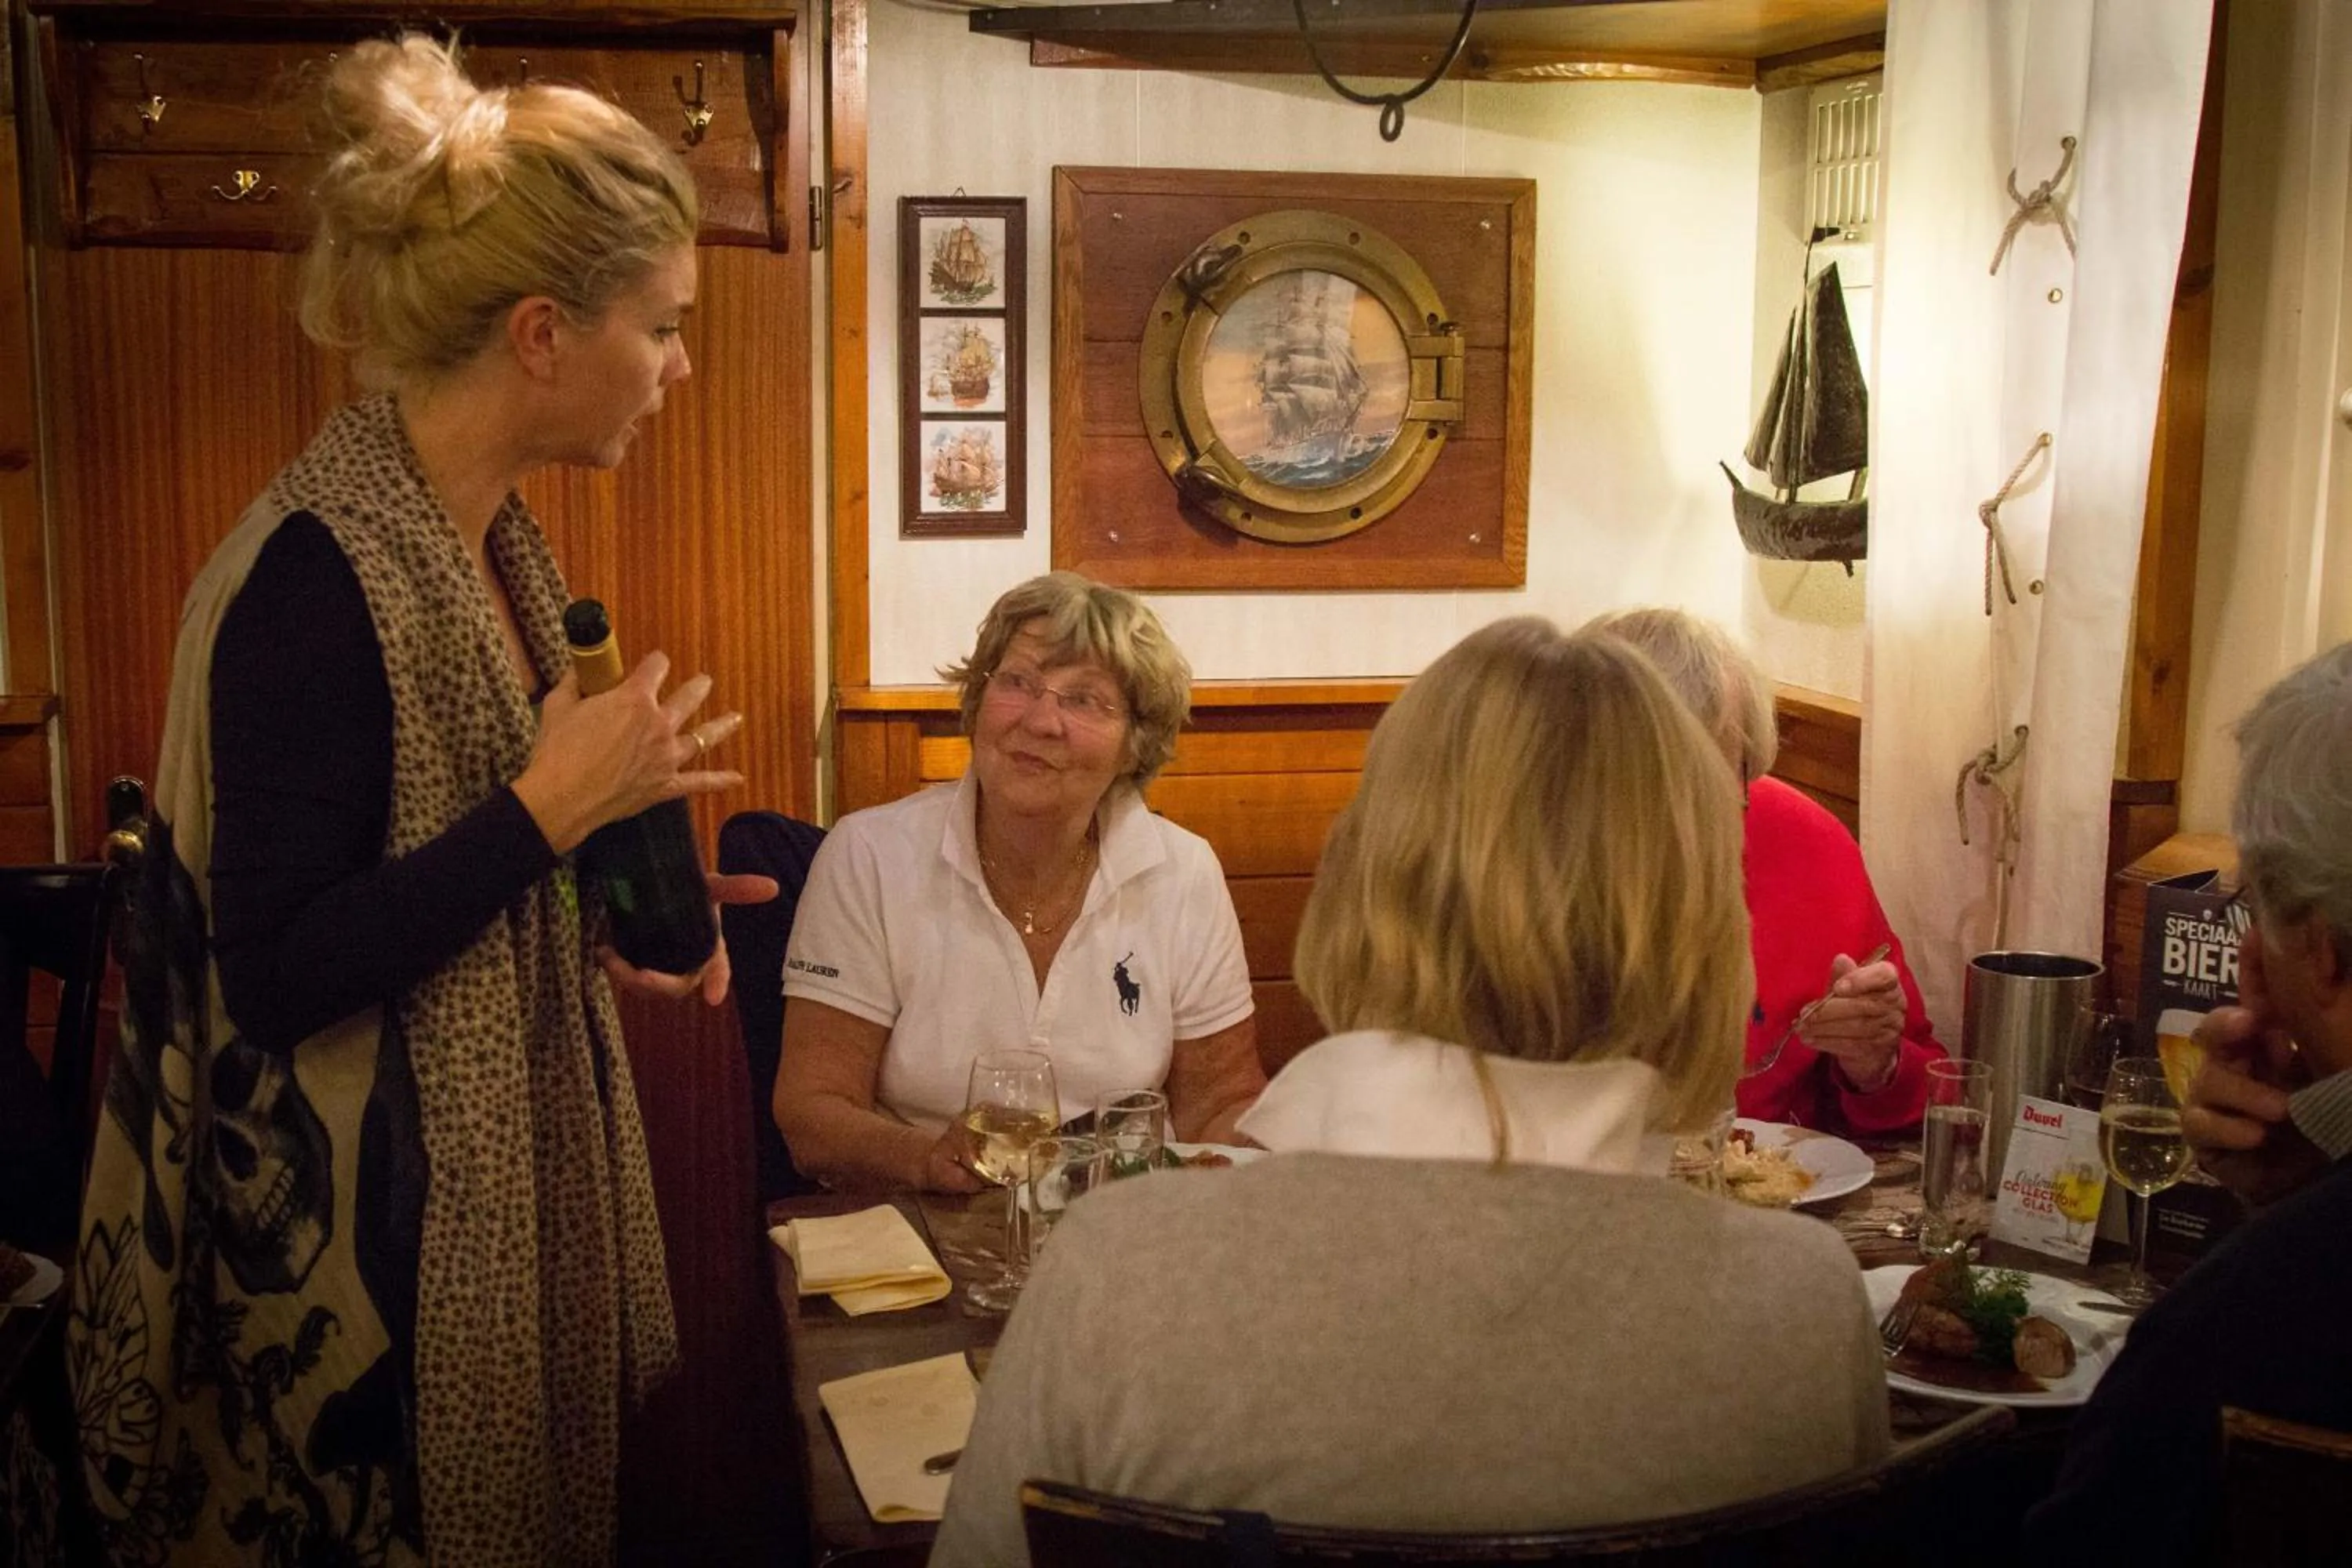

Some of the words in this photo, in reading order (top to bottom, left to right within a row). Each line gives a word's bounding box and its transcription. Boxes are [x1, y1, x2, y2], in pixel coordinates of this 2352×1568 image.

[2162, 936, 2239, 985] BIER
[2183, 979, 2218, 1000] KAART
[2023, 1105, 2063, 1129] Duvel
[2002, 1180, 2078, 1209] COLLECTION
[2022, 1197, 2053, 1214] GLAS
